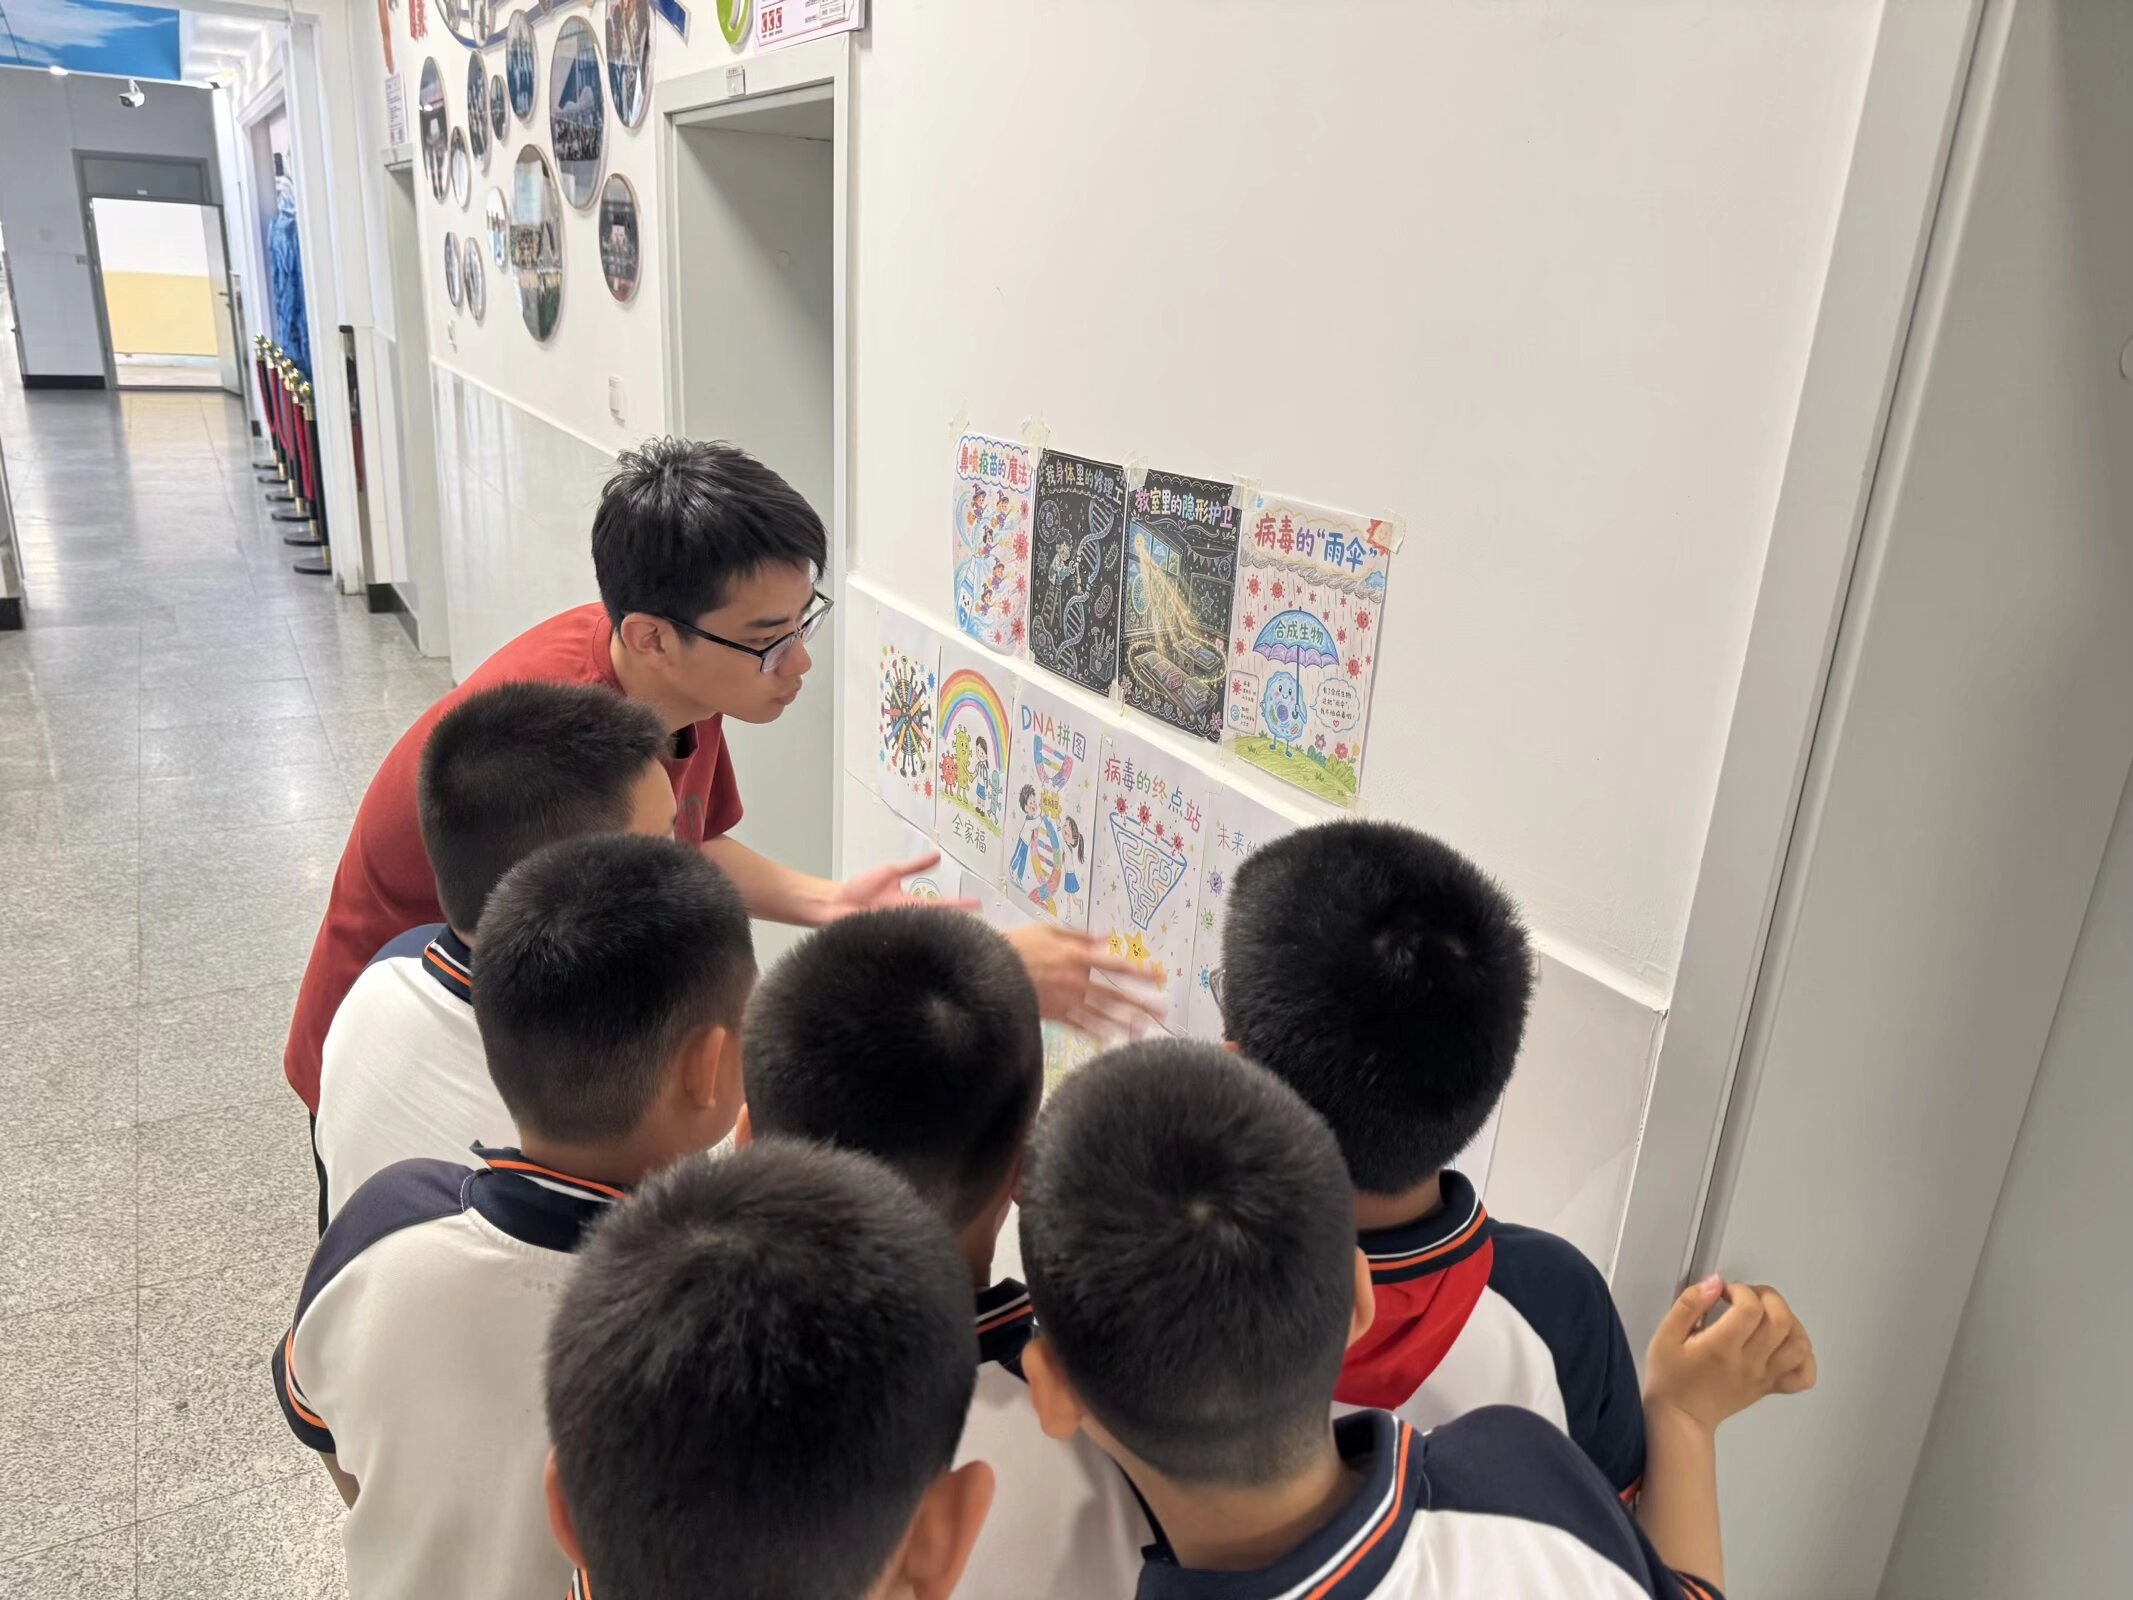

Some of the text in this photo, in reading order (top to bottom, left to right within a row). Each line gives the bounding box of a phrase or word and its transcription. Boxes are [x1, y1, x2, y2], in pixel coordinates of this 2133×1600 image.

[959, 443, 1028, 486] 鼻喷疫苗的魔法
[1045, 459, 1124, 506] 我身体里的修理工
[1135, 486, 1233, 529] 教室里的隐形护卫
[1275, 619, 1324, 646] 合成生物
[1104, 752, 1202, 834] 病毒的终点站
[952, 812, 987, 854] 全家福
